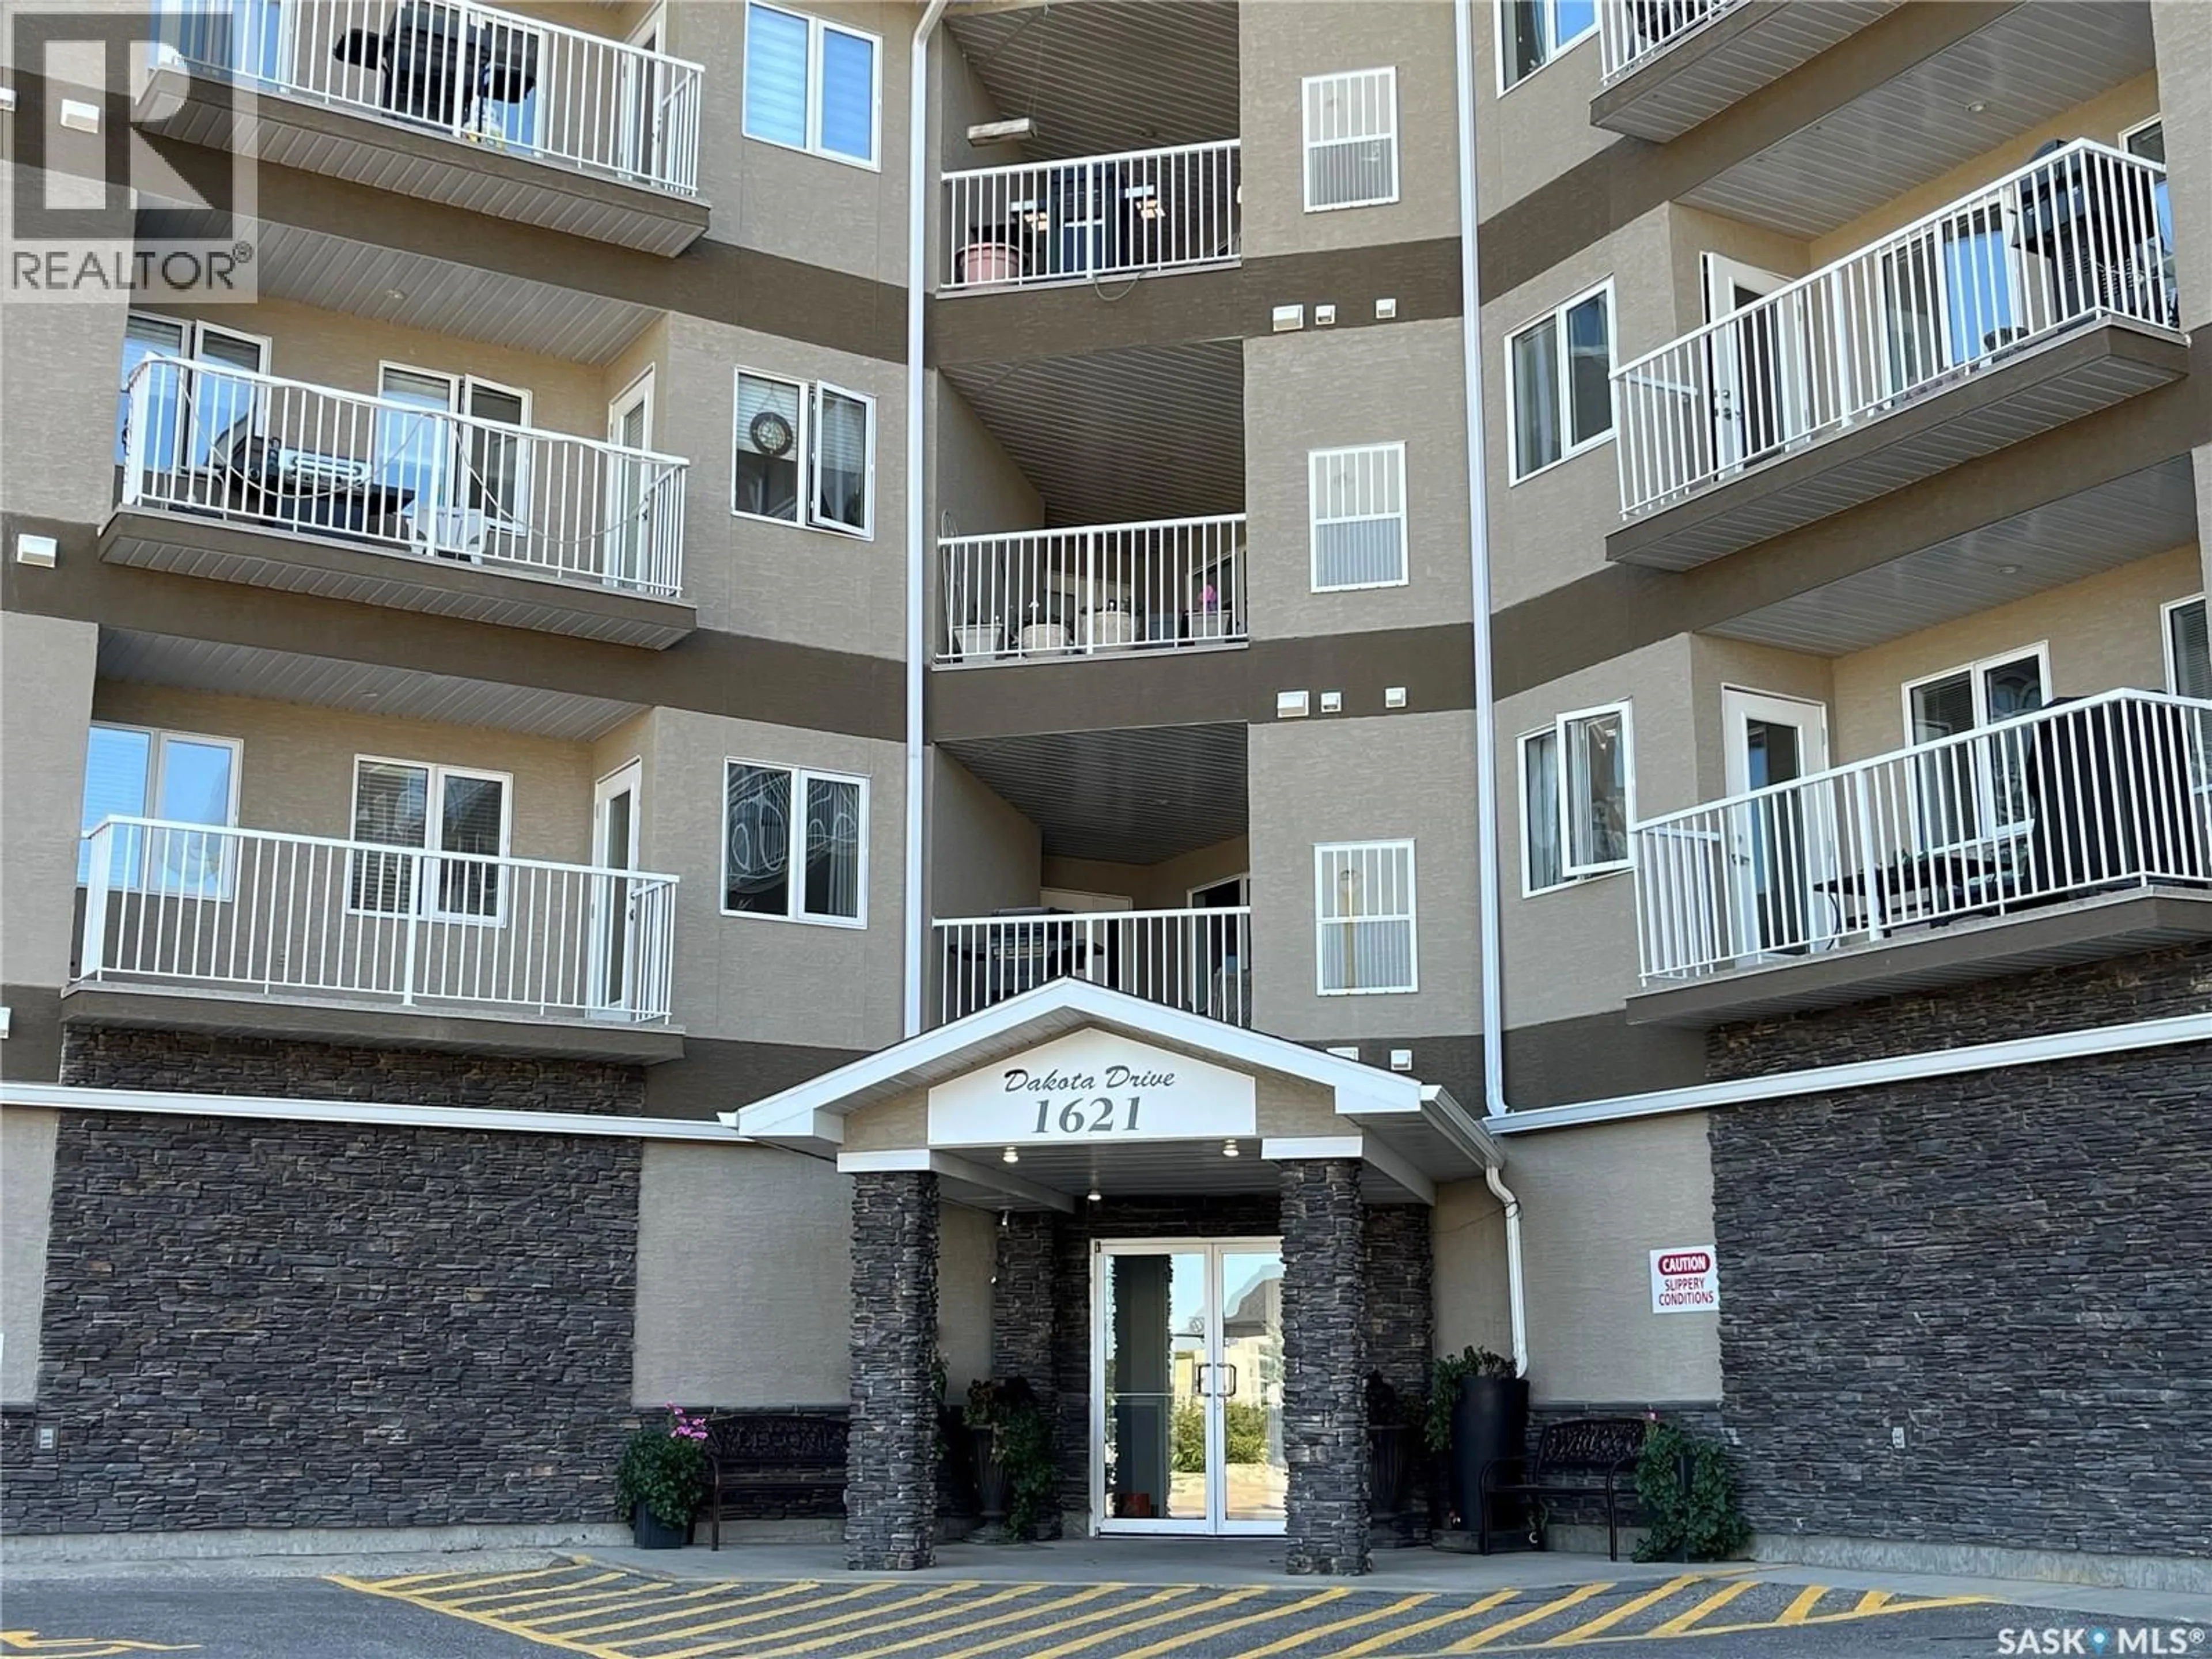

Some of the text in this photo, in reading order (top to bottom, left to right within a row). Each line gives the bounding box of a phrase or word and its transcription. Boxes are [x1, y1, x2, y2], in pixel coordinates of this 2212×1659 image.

[1003, 1065, 1175, 1092] Dakota Drive
[1032, 1096, 1140, 1134] 1621
[1662, 1256, 1706, 1272] CAUTION
[1664, 1277, 1705, 1291] SLIPPERY
[1659, 1291, 1714, 1306] CONDITIONS
